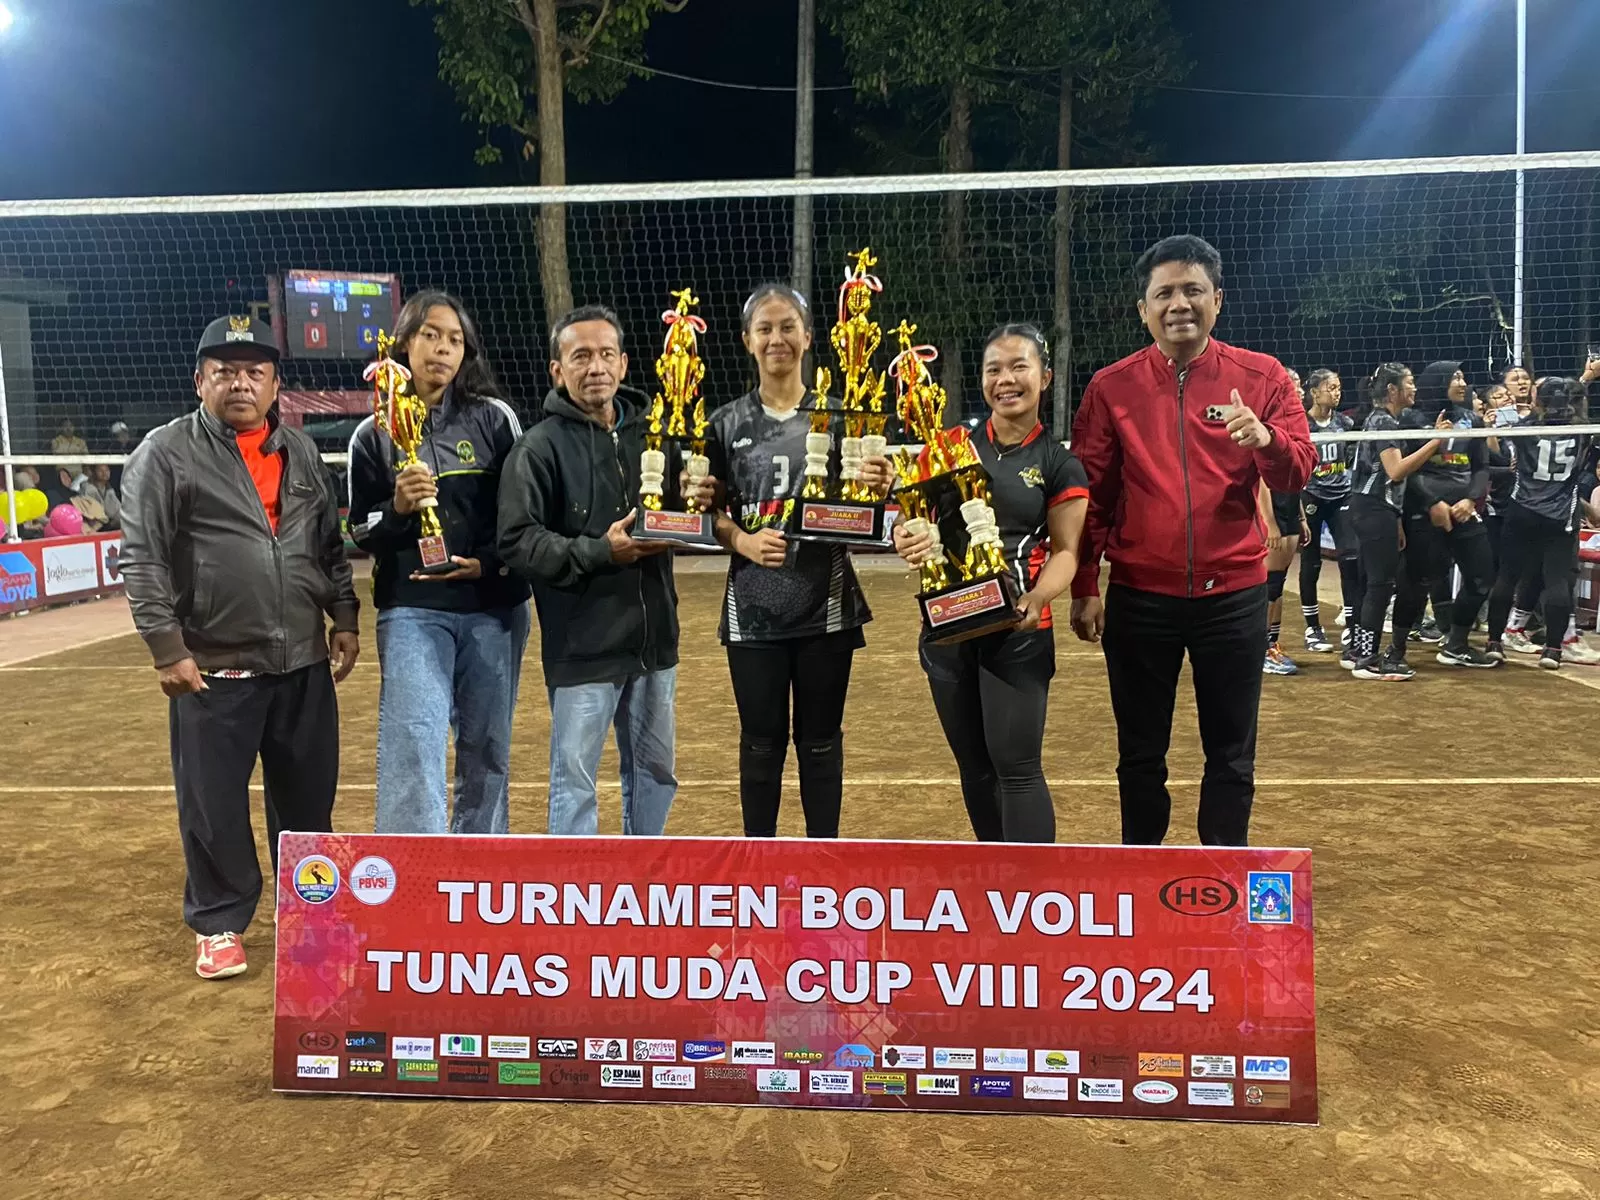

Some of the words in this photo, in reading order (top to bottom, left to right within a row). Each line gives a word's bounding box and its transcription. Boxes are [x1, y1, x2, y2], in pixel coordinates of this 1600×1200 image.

[311, 328, 319, 343] 0
[1321, 443, 1338, 461] 10
[1532, 439, 1576, 482] 15
[772, 455, 790, 494] 3
[358, 876, 388, 889] PBVSI
[1175, 886, 1222, 906] HS
[438, 881, 778, 929] TURNAMEN
[799, 885, 969, 933] BOLA
[986, 891, 1135, 937] VOLI
[366, 951, 571, 997] TUNAS
[590, 956, 767, 1002] MUDA
[784, 959, 912, 1006] CUP
[931, 963, 1039, 1009] VIII
[1061, 966, 1215, 1013] 2024
[306, 1033, 330, 1047] HS
[537, 1039, 578, 1052] GAP
[694, 1045, 723, 1053] BRILink
[784, 1052, 823, 1060] IBARBO
[985, 1055, 999, 1063] BANK
[613, 1069, 624, 1078] KSP
[655, 1070, 692, 1082] citranet
